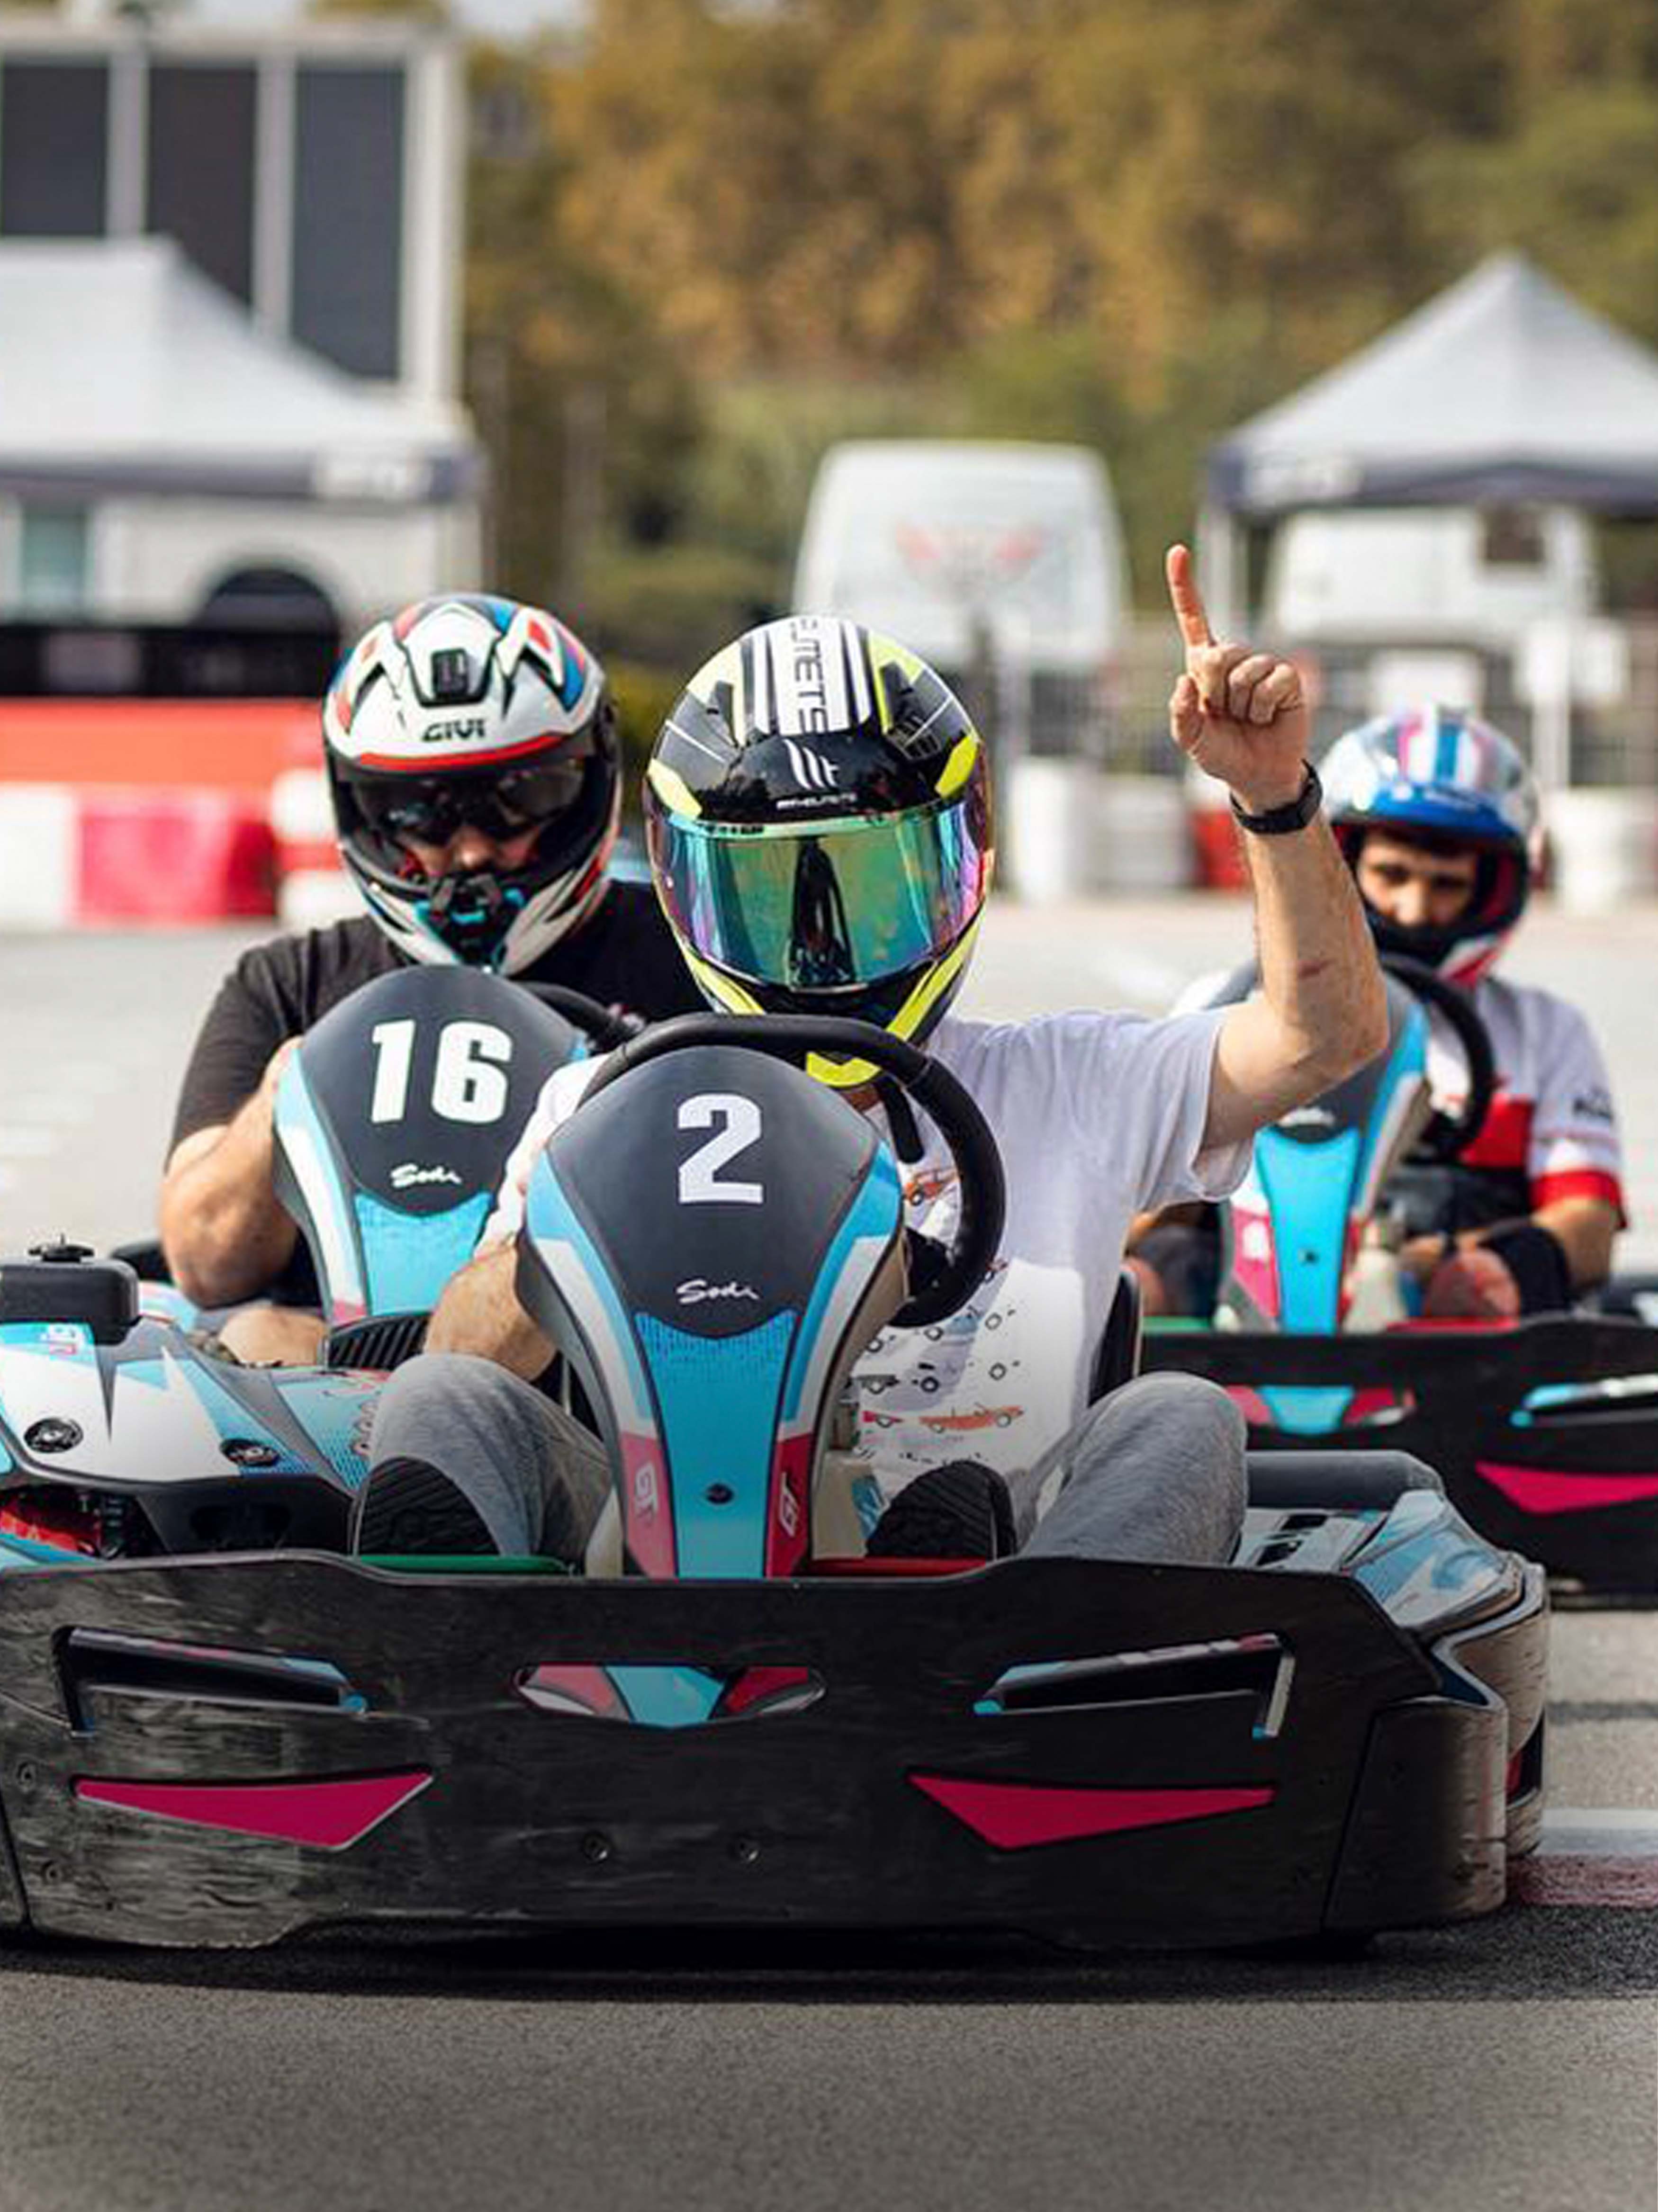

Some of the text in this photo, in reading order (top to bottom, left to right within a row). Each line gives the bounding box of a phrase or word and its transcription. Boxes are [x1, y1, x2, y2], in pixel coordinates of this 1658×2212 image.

[422, 719, 485, 742] GIVI
[371, 1019, 513, 1124] 16
[677, 1093, 764, 1204] 2
